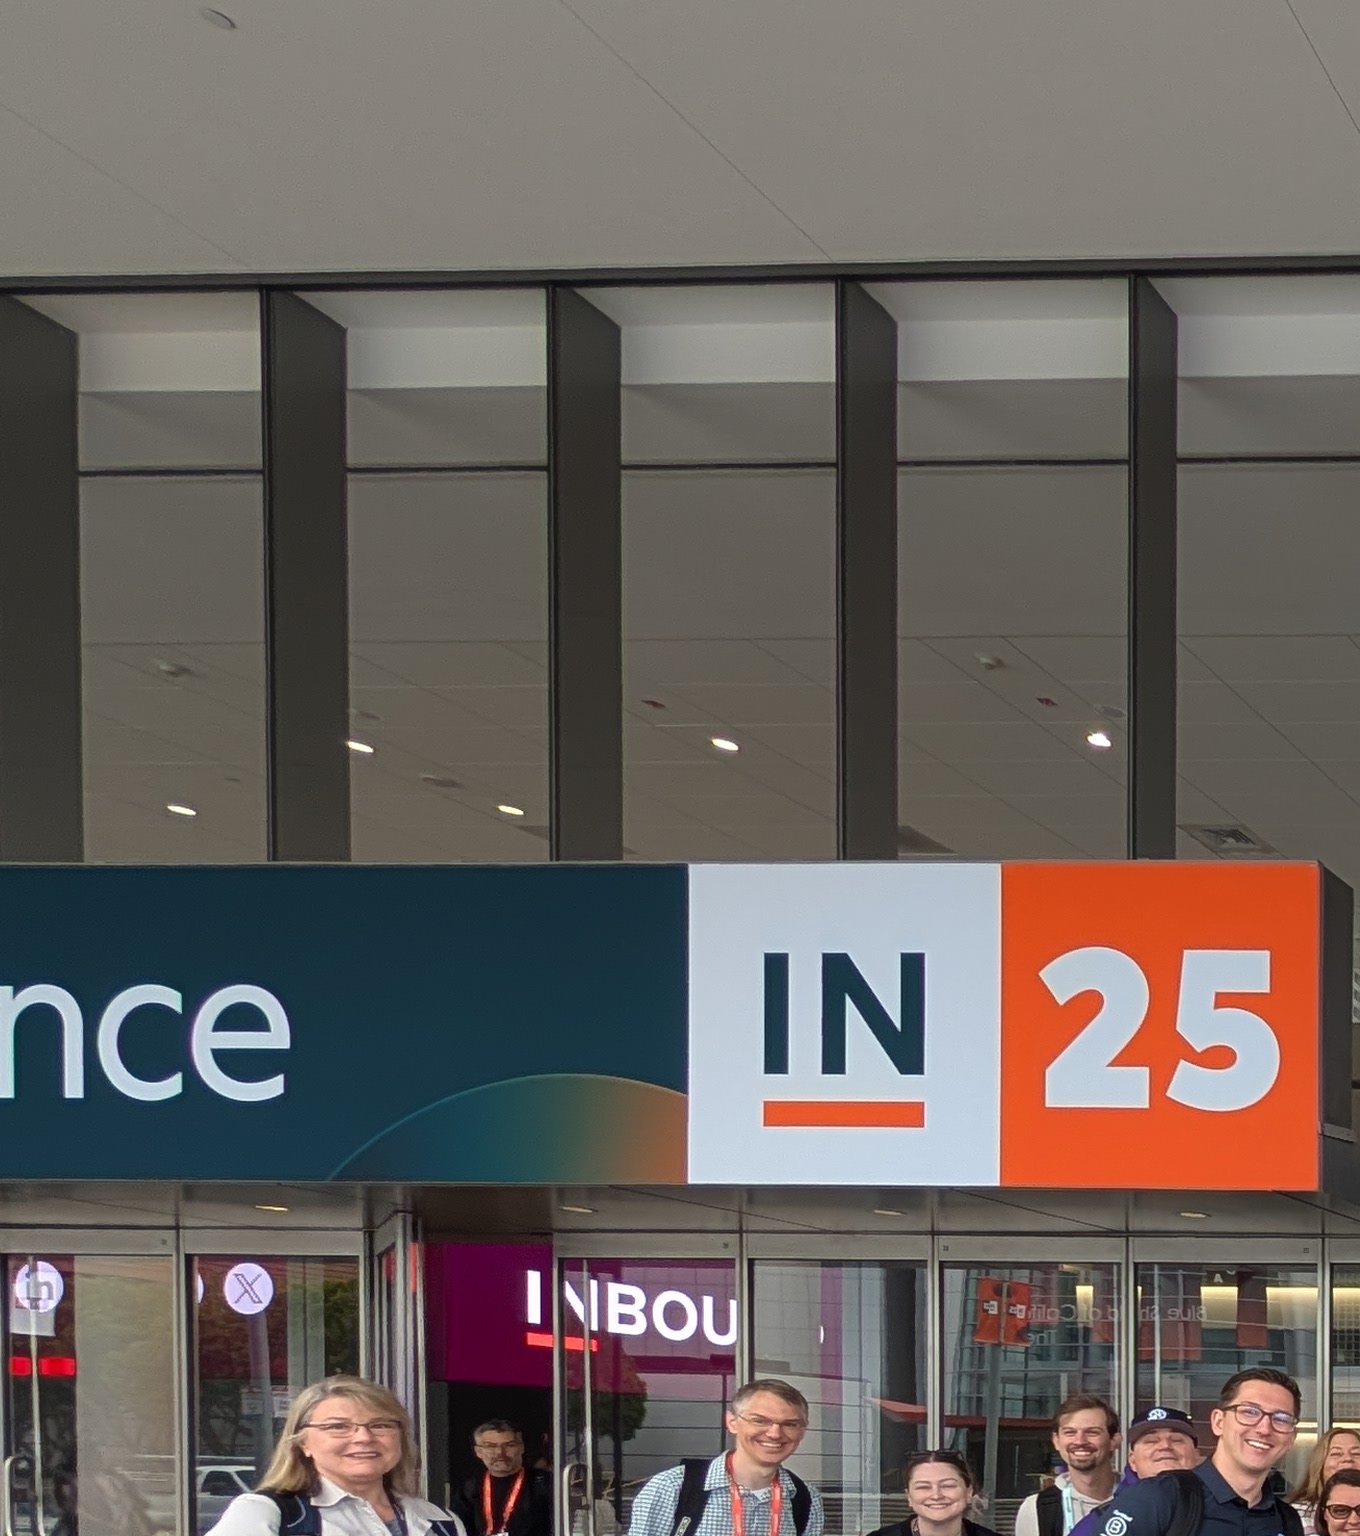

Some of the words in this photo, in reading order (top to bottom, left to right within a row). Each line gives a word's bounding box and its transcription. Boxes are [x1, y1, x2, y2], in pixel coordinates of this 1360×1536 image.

[0, 983, 292, 1103] nce
[763, 952, 926, 1076] IN
[1038, 946, 1281, 1112] 25
[526, 1269, 738, 1346] INBOU
